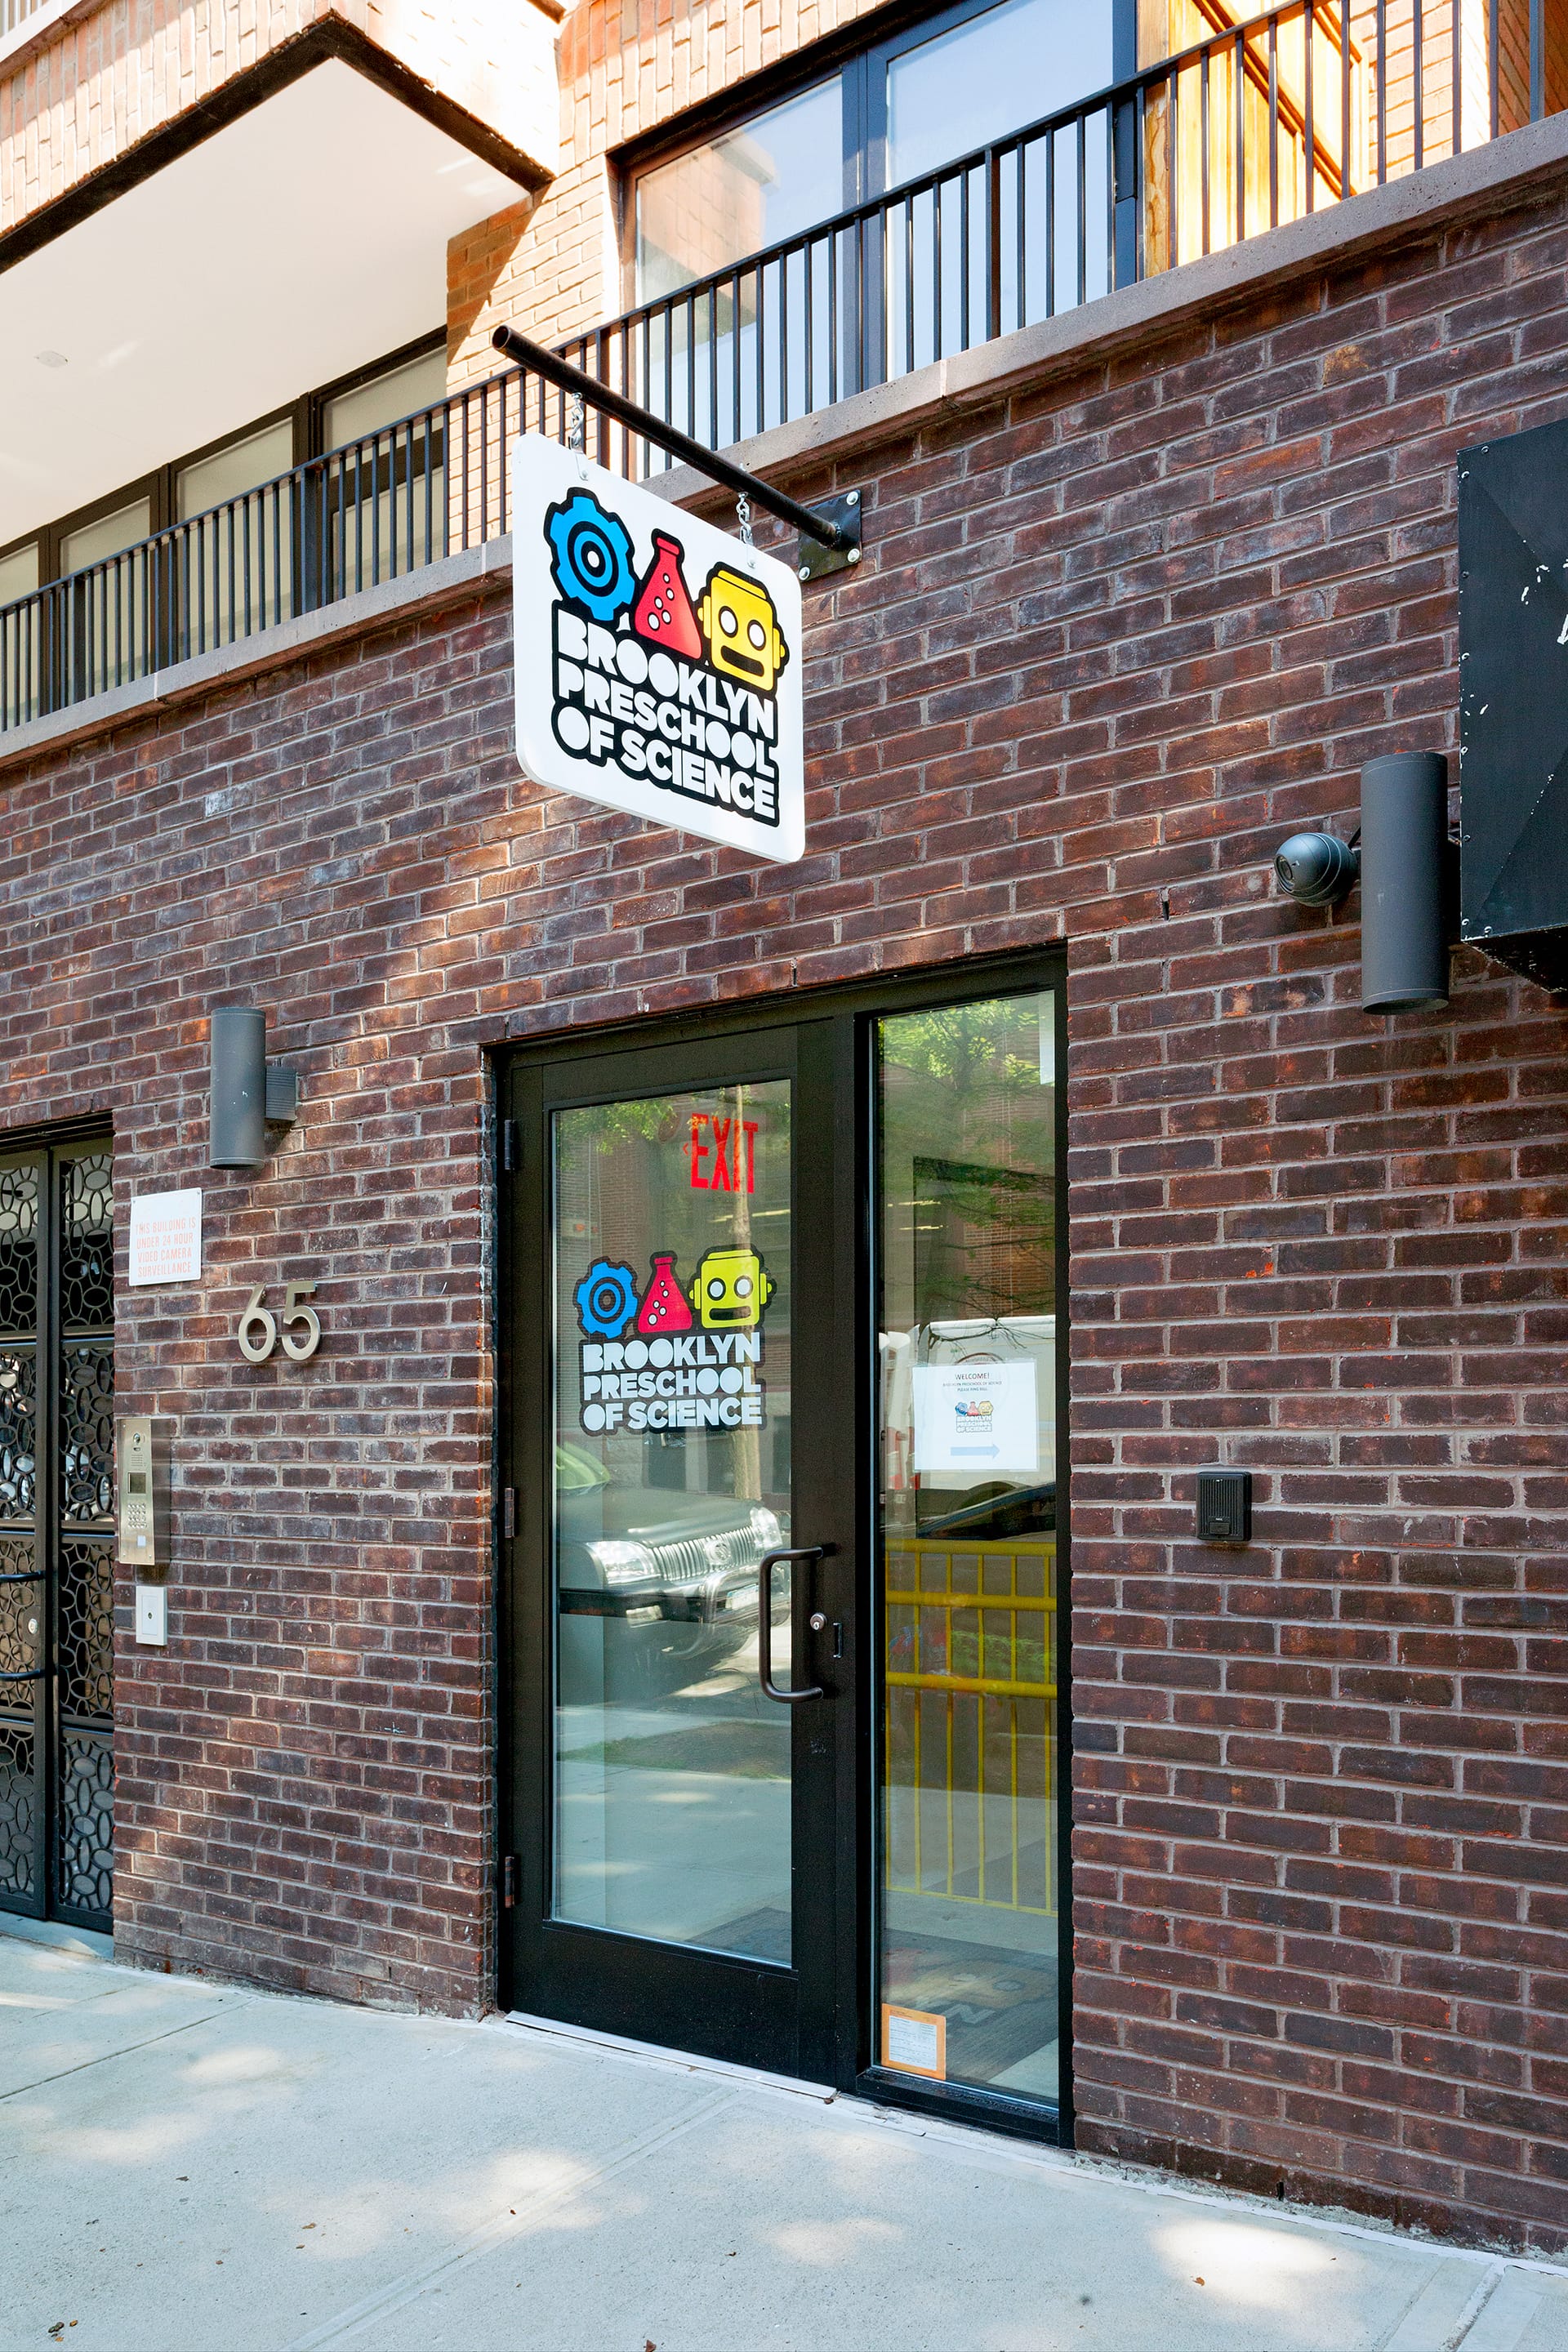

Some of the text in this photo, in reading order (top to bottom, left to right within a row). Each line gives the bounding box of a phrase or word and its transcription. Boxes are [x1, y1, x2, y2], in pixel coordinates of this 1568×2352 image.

[558, 608, 774, 740] BROOKLYN
[558, 657, 775, 778] PRESCHOOL
[557, 706, 775, 819] OF SCIENCE
[690, 1112, 759, 1195] EXIT
[136, 1216, 197, 1235] THIS BUILDING IS
[136, 1232, 194, 1250] UNDER 24 HOUR
[137, 1247, 192, 1263] VIDEO CAMERA
[137, 1261, 192, 1278] SURVEILLANCE
[238, 1280, 321, 1363] 65
[582, 1332, 761, 1373] BROOKLYN
[583, 1366, 762, 1401] PRESCHOOL
[955, 1372, 990, 1380] WELCOME!
[582, 1396, 763, 1432] OF SCIENCE
